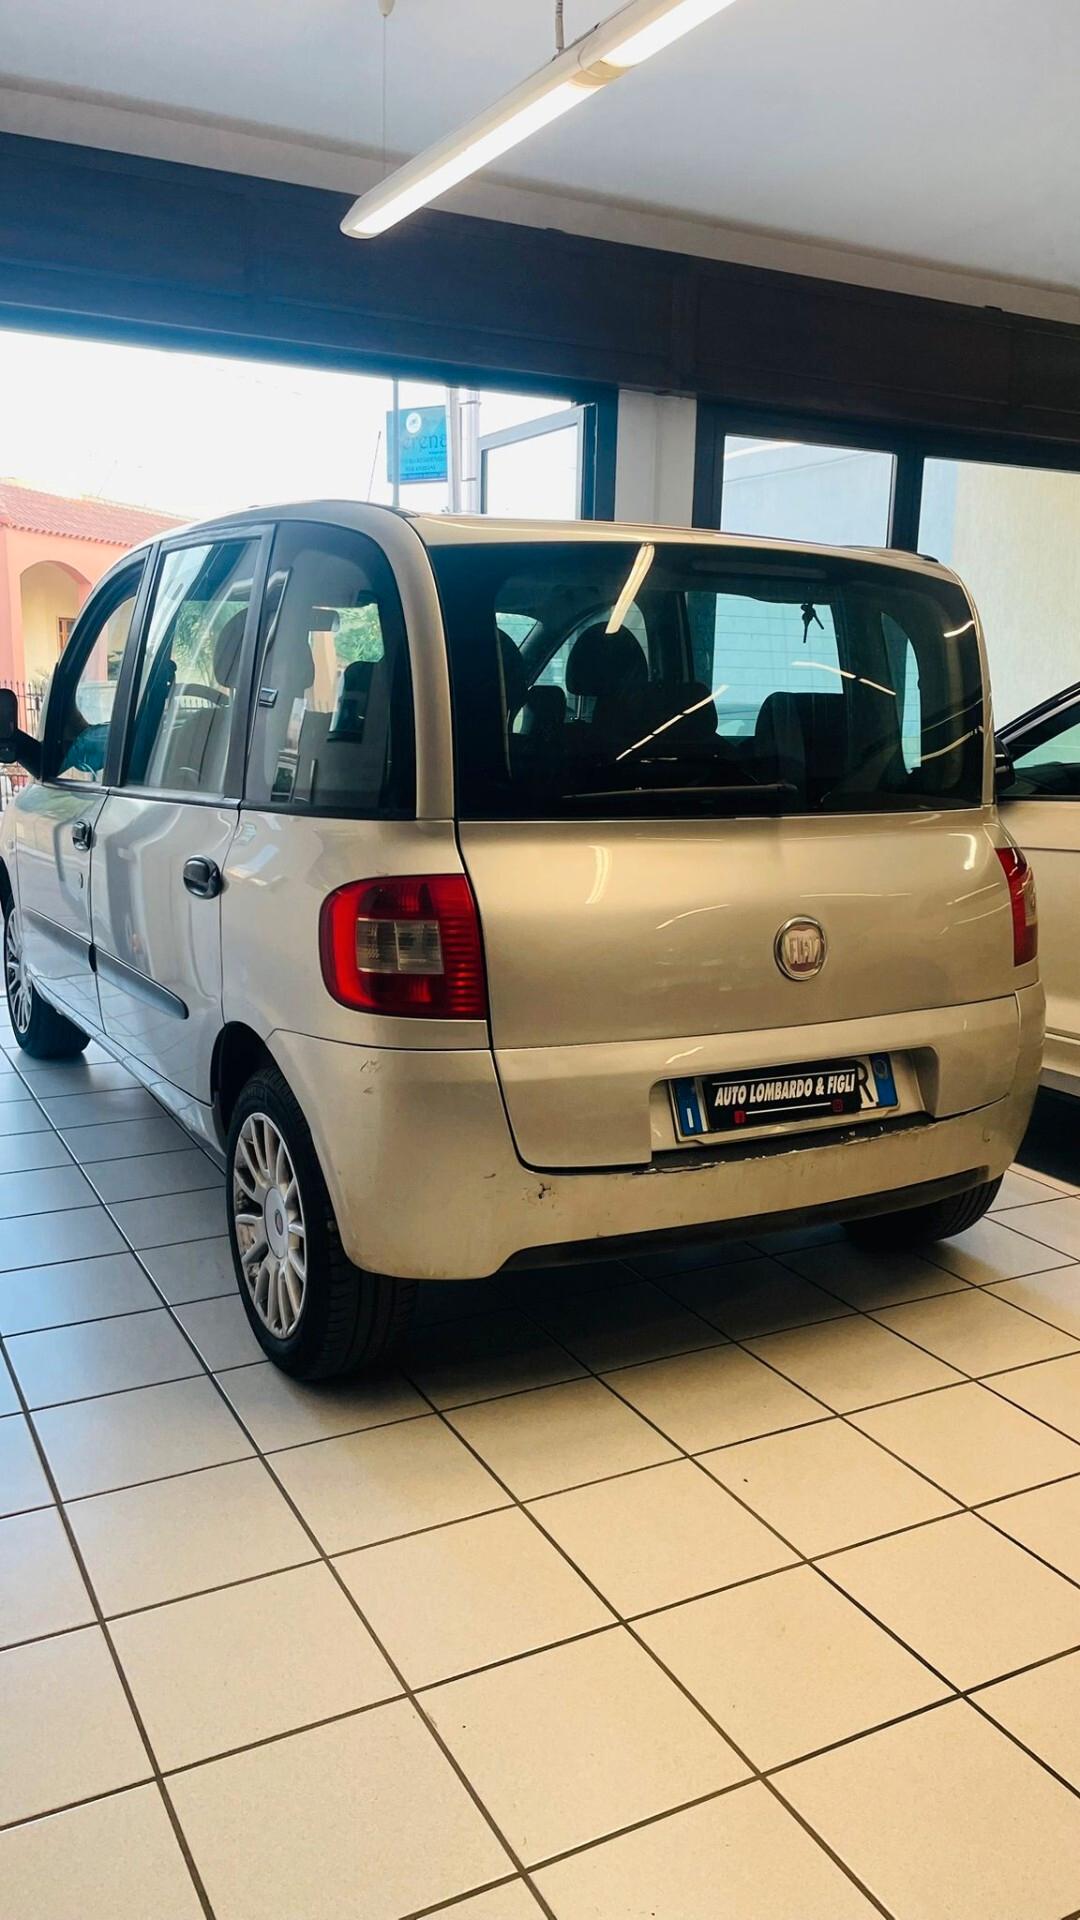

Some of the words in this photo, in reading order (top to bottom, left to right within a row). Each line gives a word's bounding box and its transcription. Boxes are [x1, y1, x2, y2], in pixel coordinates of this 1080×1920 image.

[714, 1085, 747, 1106] AUTO
[749, 1078, 813, 1103] LOMBARDO
[815, 1077, 825, 1096] &
[827, 1073, 855, 1095] FIGLI
